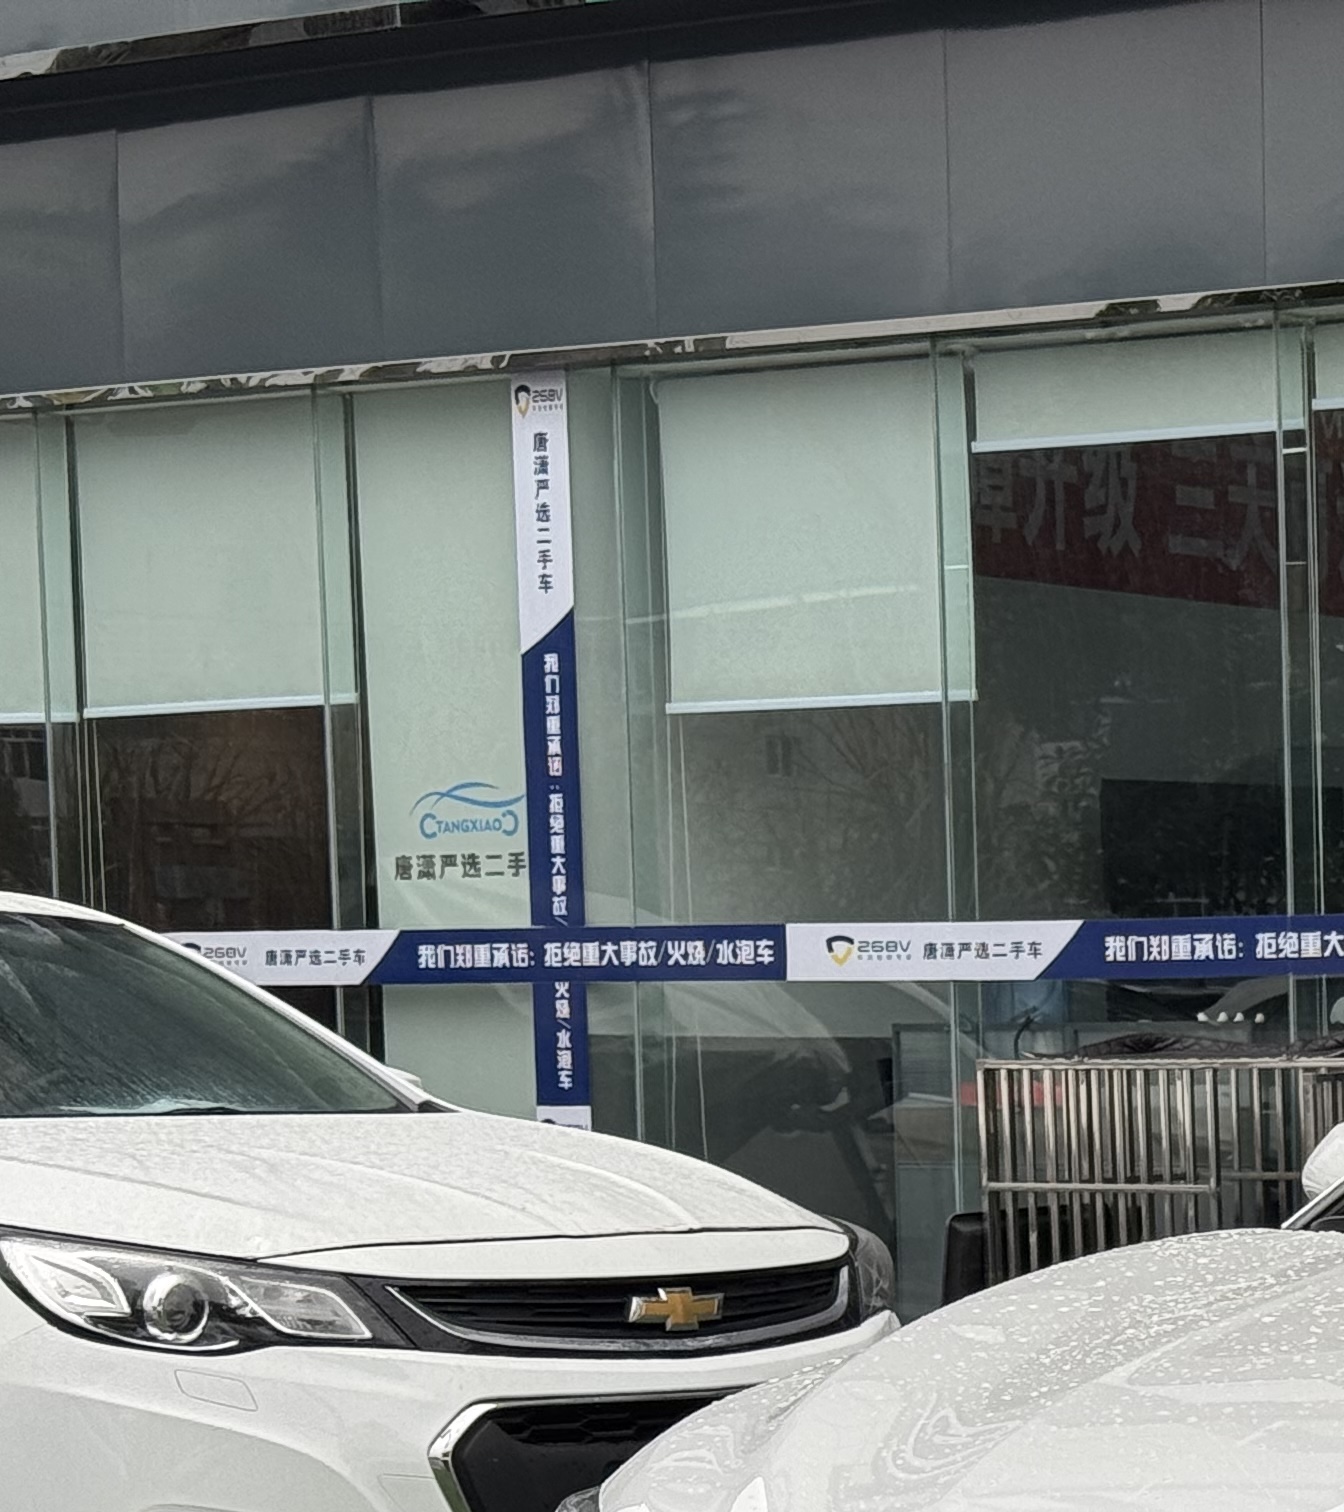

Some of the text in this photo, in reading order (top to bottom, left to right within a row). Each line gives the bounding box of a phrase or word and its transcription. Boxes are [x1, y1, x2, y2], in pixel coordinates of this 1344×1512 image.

[533, 431, 554, 595] 唐潇严选二手车
[264, 949, 367, 967] 唐潇严选二手车
[922, 940, 1044, 960] 唐潇严选二手车
